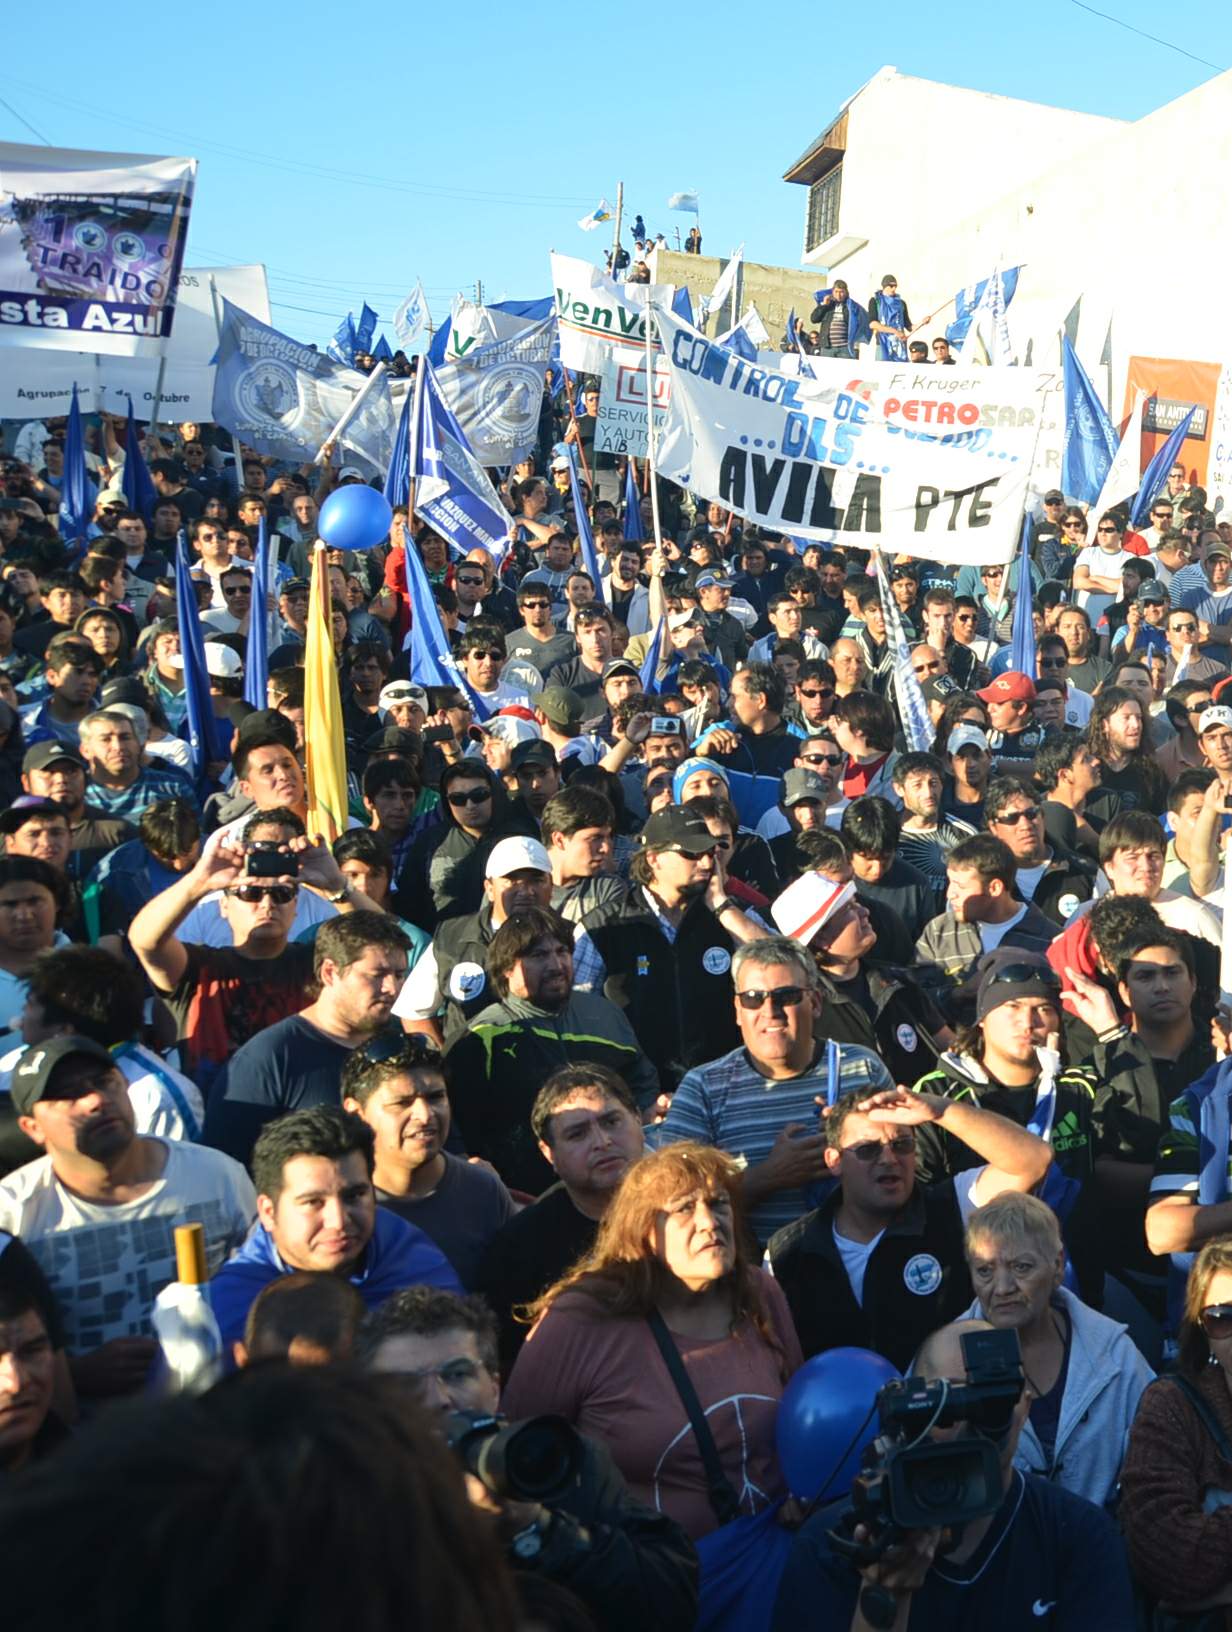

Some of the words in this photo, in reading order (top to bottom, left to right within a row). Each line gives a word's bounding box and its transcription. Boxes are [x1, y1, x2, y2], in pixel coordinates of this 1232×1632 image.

[81, 303, 164, 337] Azul
[17, 388, 90, 400] Agrupacon
[671, 329, 804, 410] CONTROL
[833, 393, 869, 425] DE
[912, 375, 982, 393] Kruger
[719, 446, 881, 533] AVILA
[914, 477, 1001, 532] PTE
[440, 496, 478, 532] VAZQUEZ
